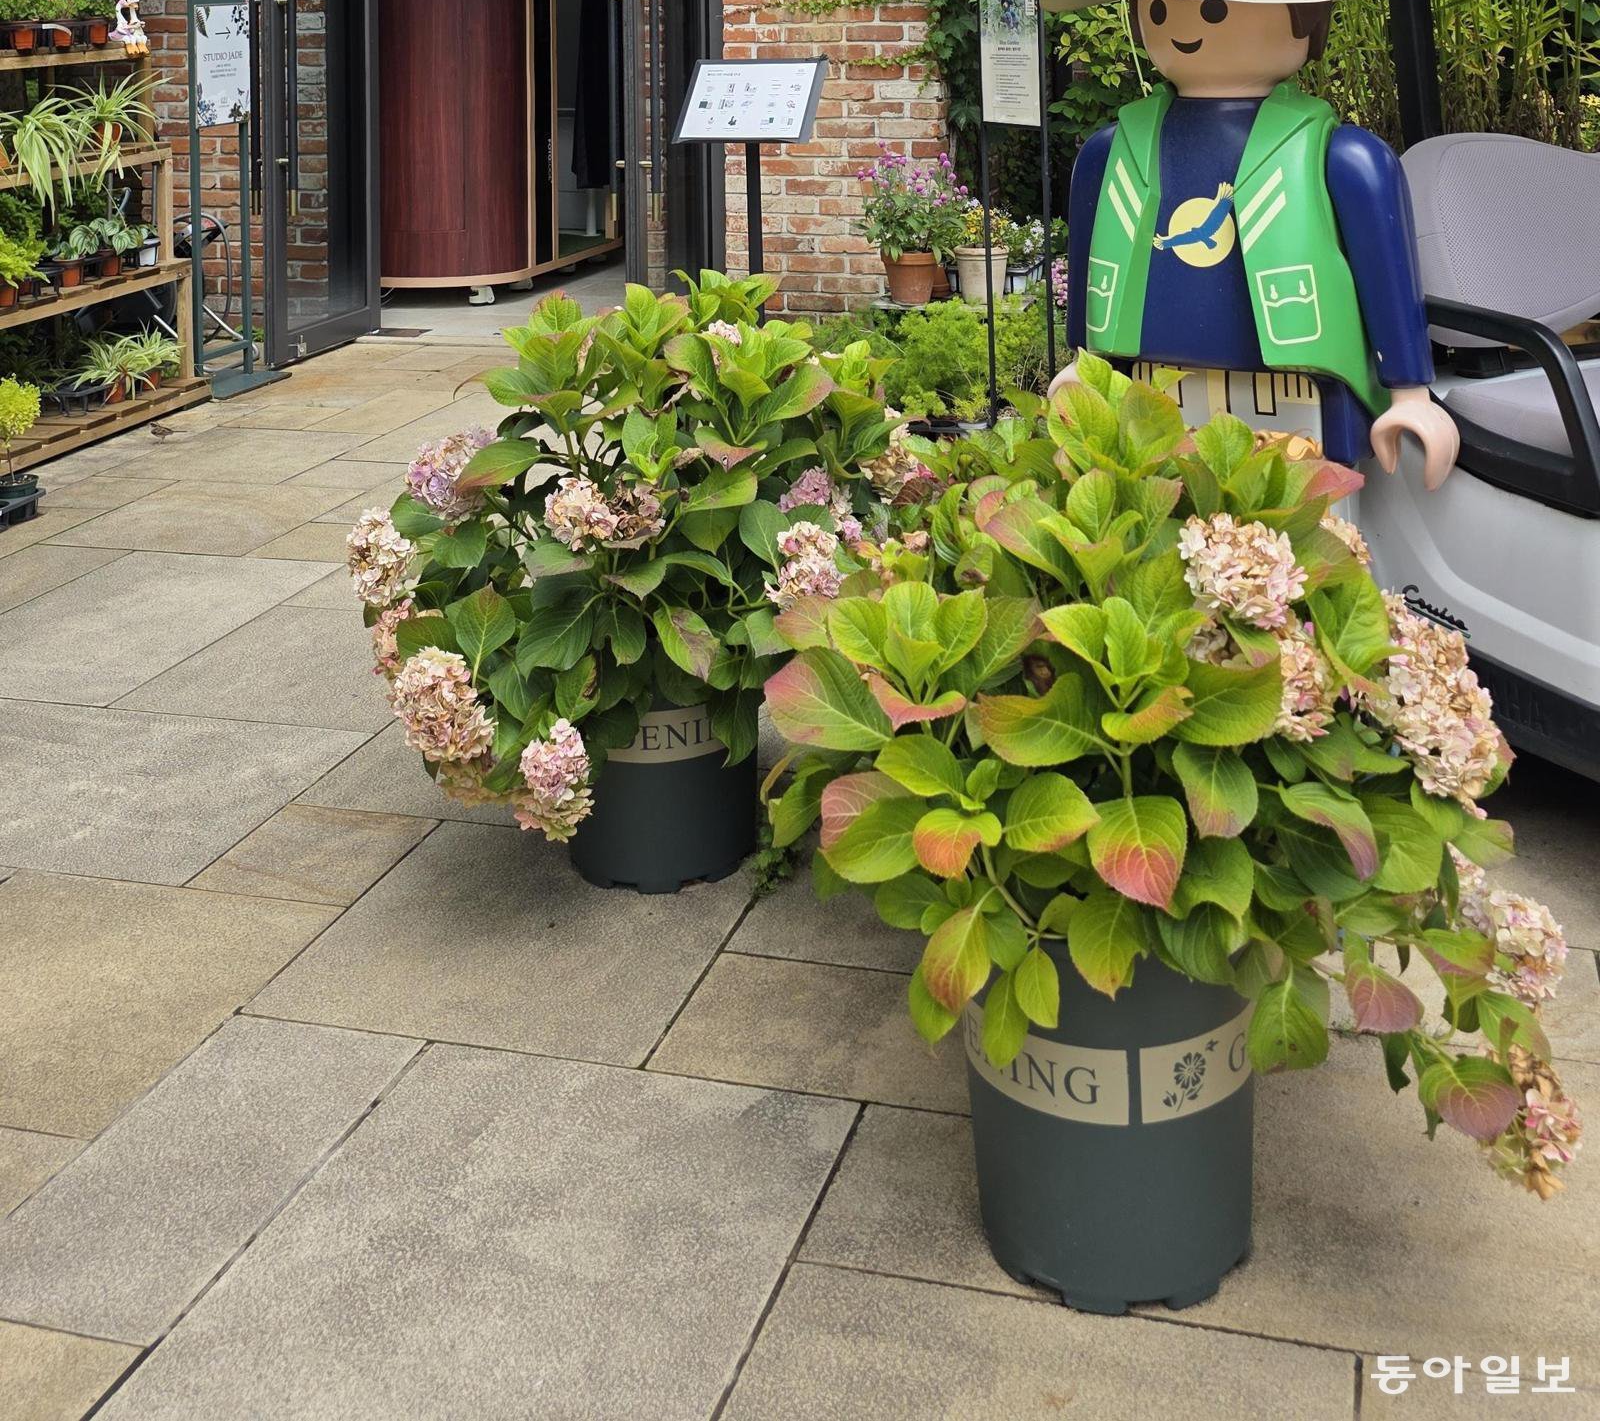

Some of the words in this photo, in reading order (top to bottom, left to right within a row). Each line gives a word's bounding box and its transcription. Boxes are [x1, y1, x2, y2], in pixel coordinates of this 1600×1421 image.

[203, 52, 227, 62] STUDIO
[228, 50, 243, 61] JADE
[623, 719, 713, 751] ENI
